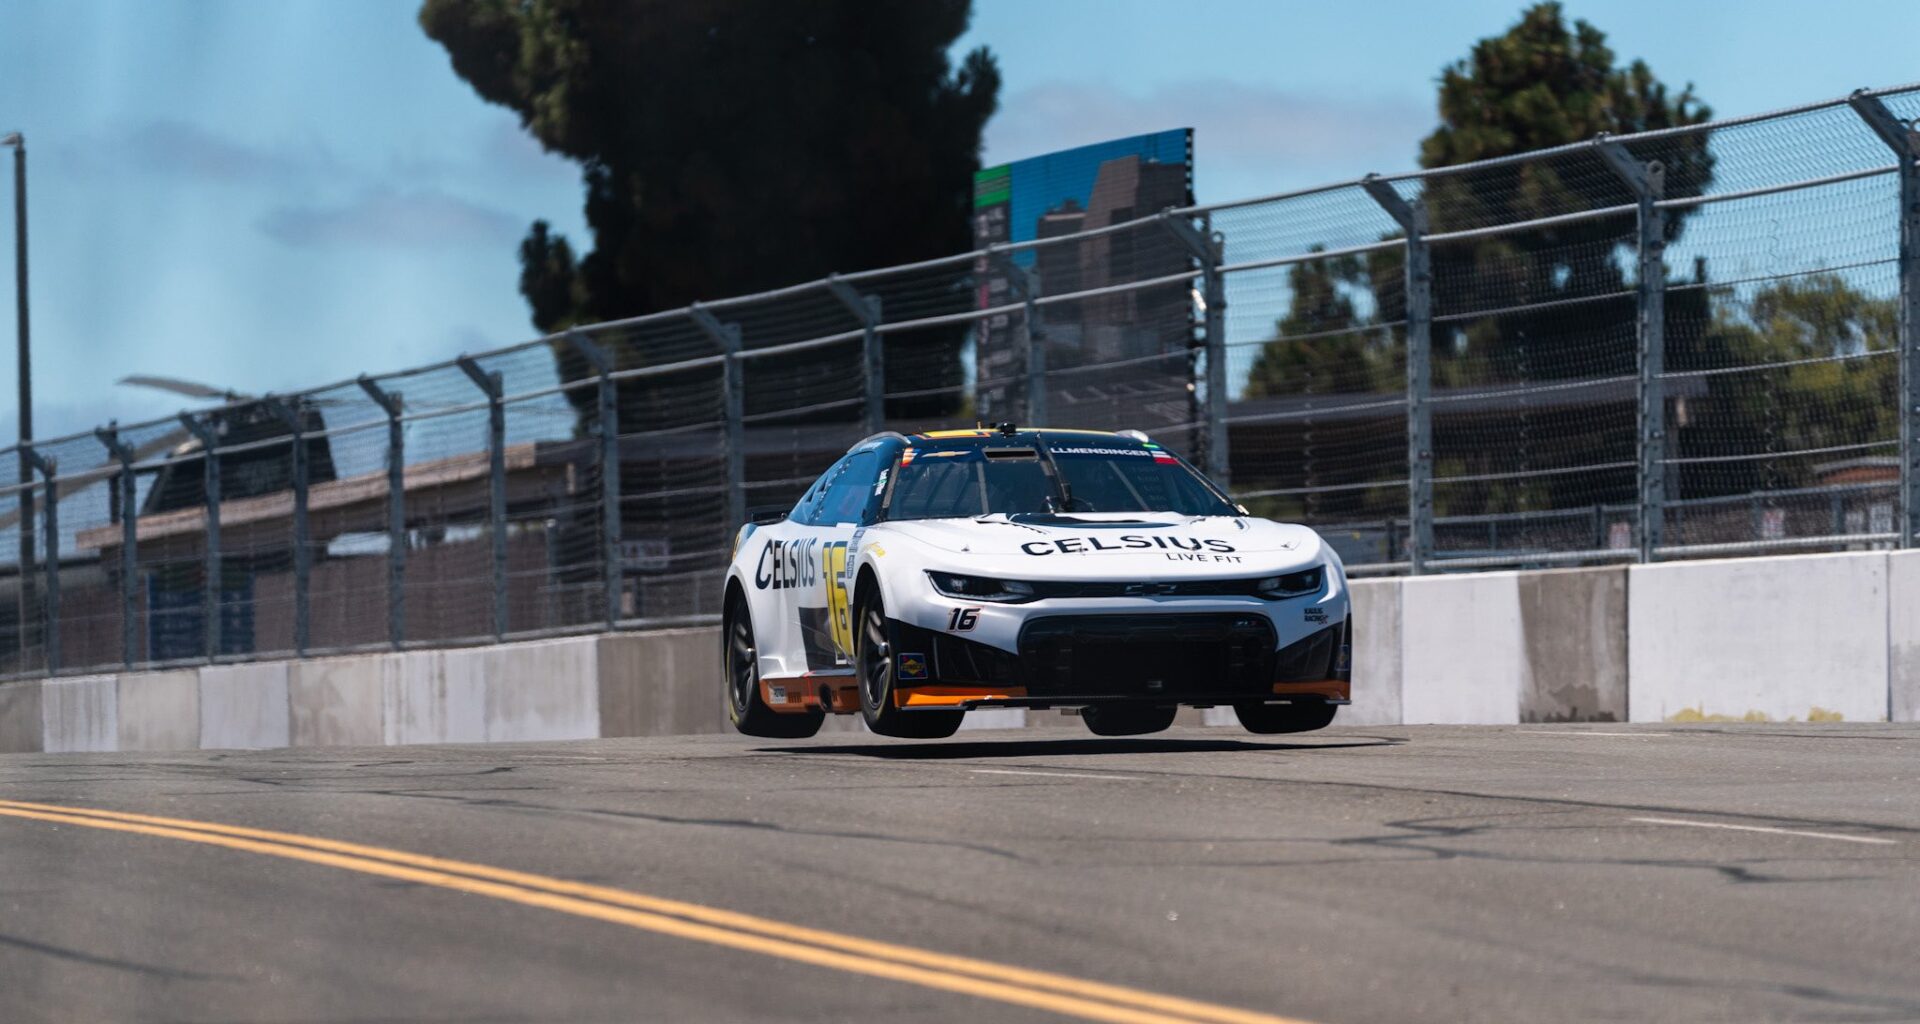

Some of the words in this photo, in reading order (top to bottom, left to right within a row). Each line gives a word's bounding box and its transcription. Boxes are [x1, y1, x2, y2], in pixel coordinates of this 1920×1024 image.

[1050, 446, 1151, 457] LLMENDINGER
[1021, 535, 1236, 556] CELSIUS
[755, 537, 817, 590] CELSIUS
[1166, 552, 1208, 562] LIVE
[1213, 555, 1243, 564] FIT
[822, 541, 857, 665] 16
[947, 606, 983, 632] 16
